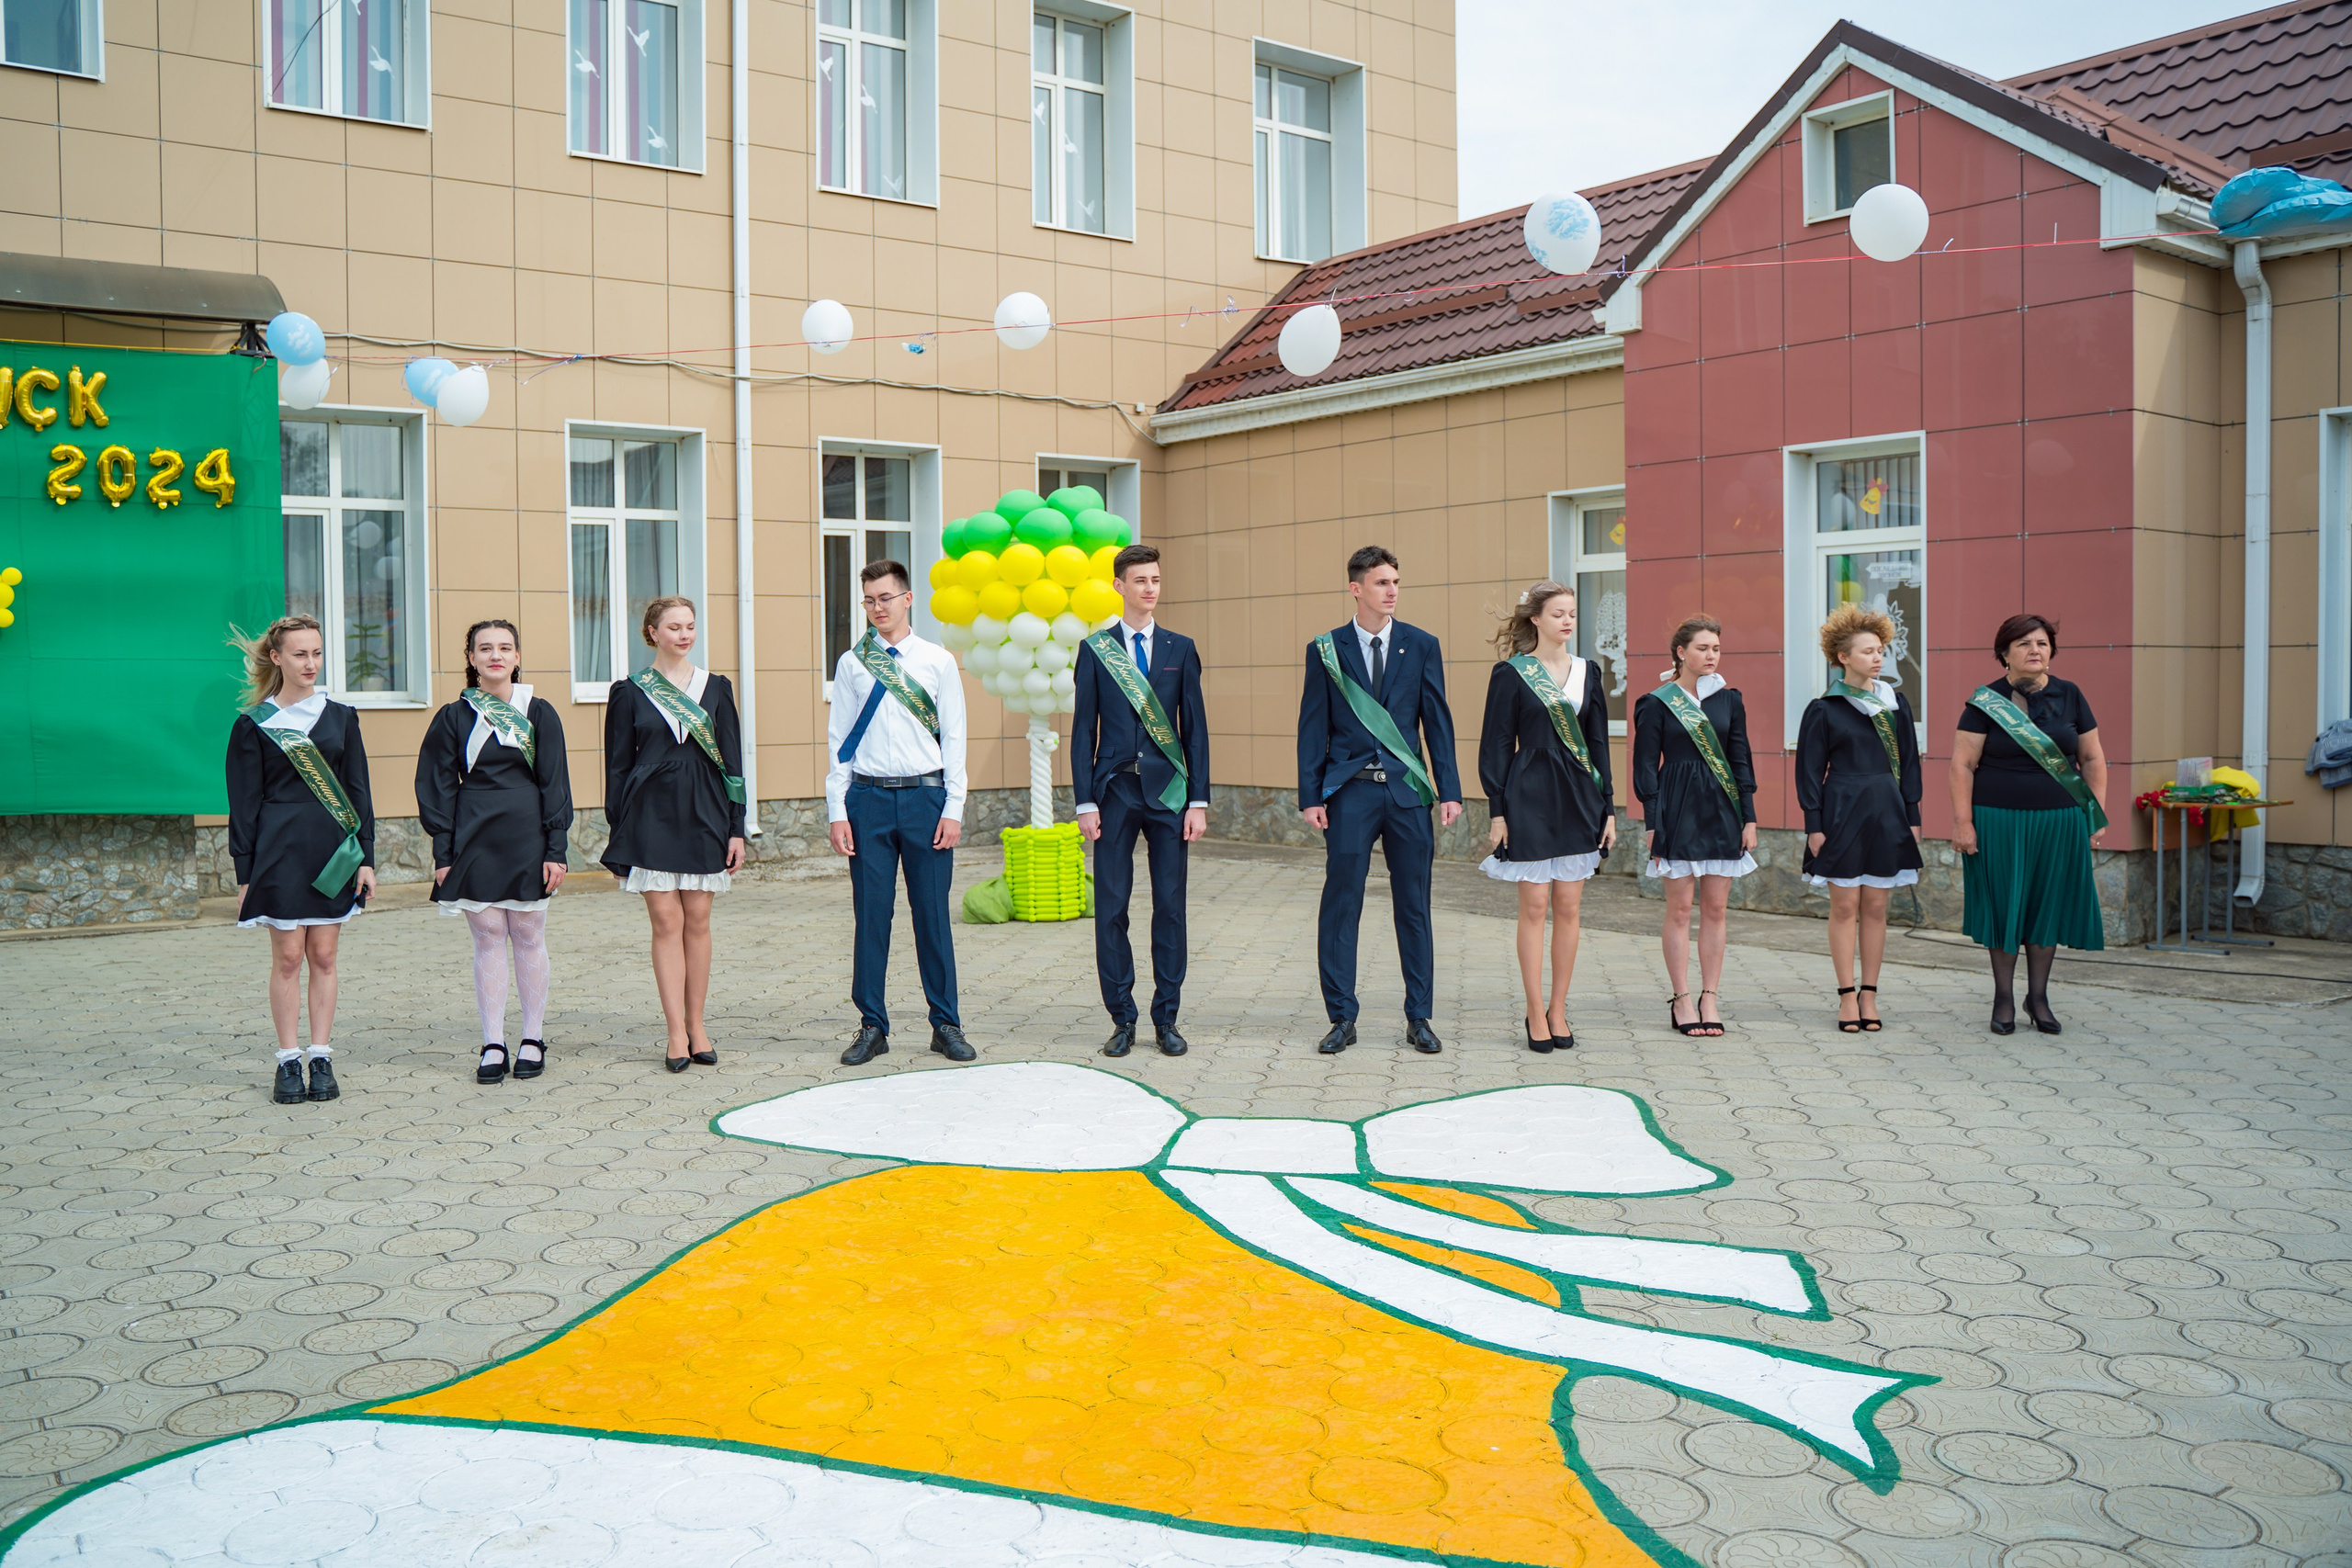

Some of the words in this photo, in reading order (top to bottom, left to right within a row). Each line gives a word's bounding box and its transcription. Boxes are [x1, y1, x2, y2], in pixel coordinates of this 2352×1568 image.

[47, 443, 236, 509] 2024
[651, 682, 715, 745] Выпускница
[866, 651, 928, 712] Выпускник
[1105, 651, 1158, 723] Выпускник
[1153, 725, 1174, 745] 2024
[280, 732, 341, 808] Выпускница
[1681, 709, 1729, 780] Выпускница
